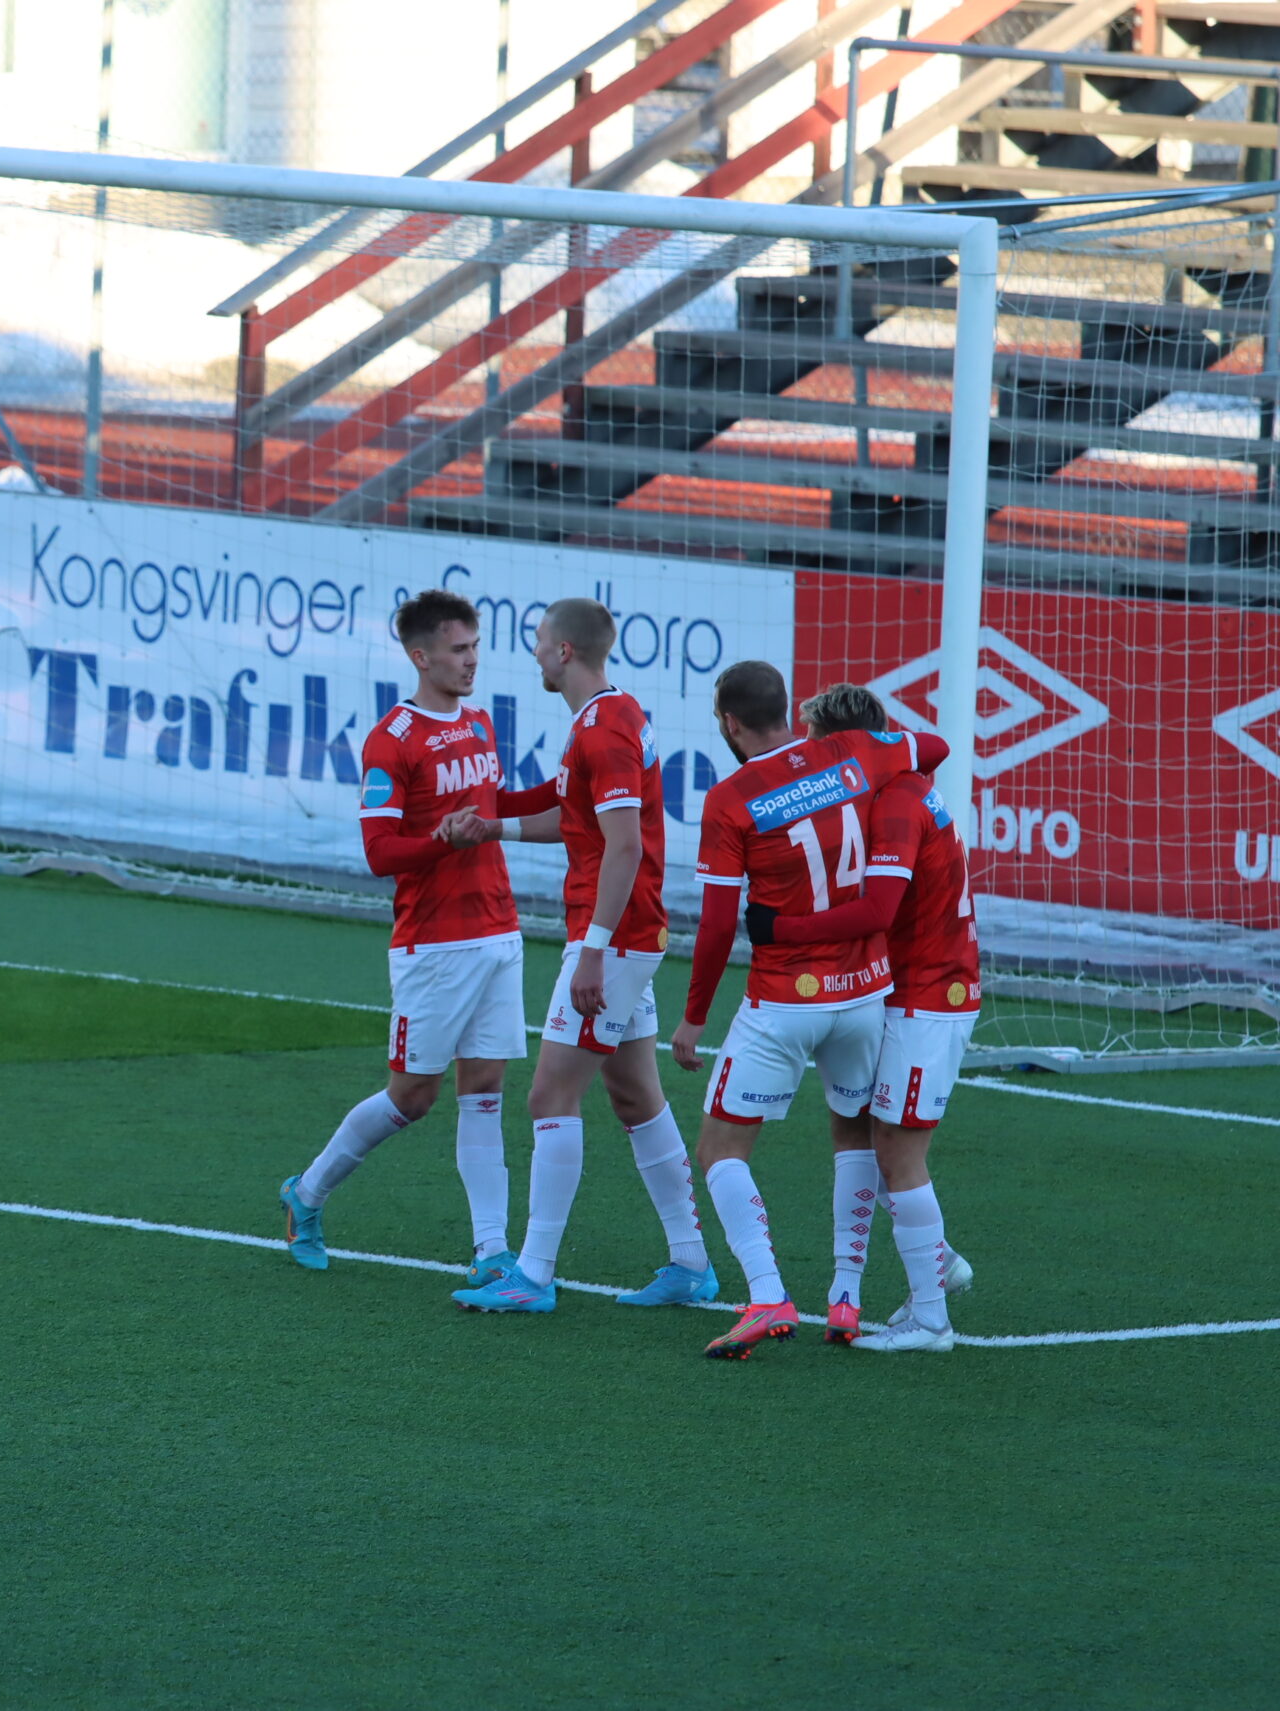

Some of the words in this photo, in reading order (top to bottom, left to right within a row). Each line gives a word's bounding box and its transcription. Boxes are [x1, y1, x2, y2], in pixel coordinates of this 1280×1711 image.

[31, 523, 365, 658] Kongsvinger
[442, 564, 723, 699] metorp
[604, 787, 629, 799] umbro
[751, 773, 841, 818] SpareBank
[844, 767, 858, 788] 1
[782, 788, 846, 820] ØSTLANDET
[970, 788, 1081, 859] bro
[787, 803, 868, 912] 14
[823, 972, 855, 993] RIGHT
[856, 967, 872, 987] TO
[871, 955, 891, 980] PLA
[879, 1083, 890, 1096] 23
